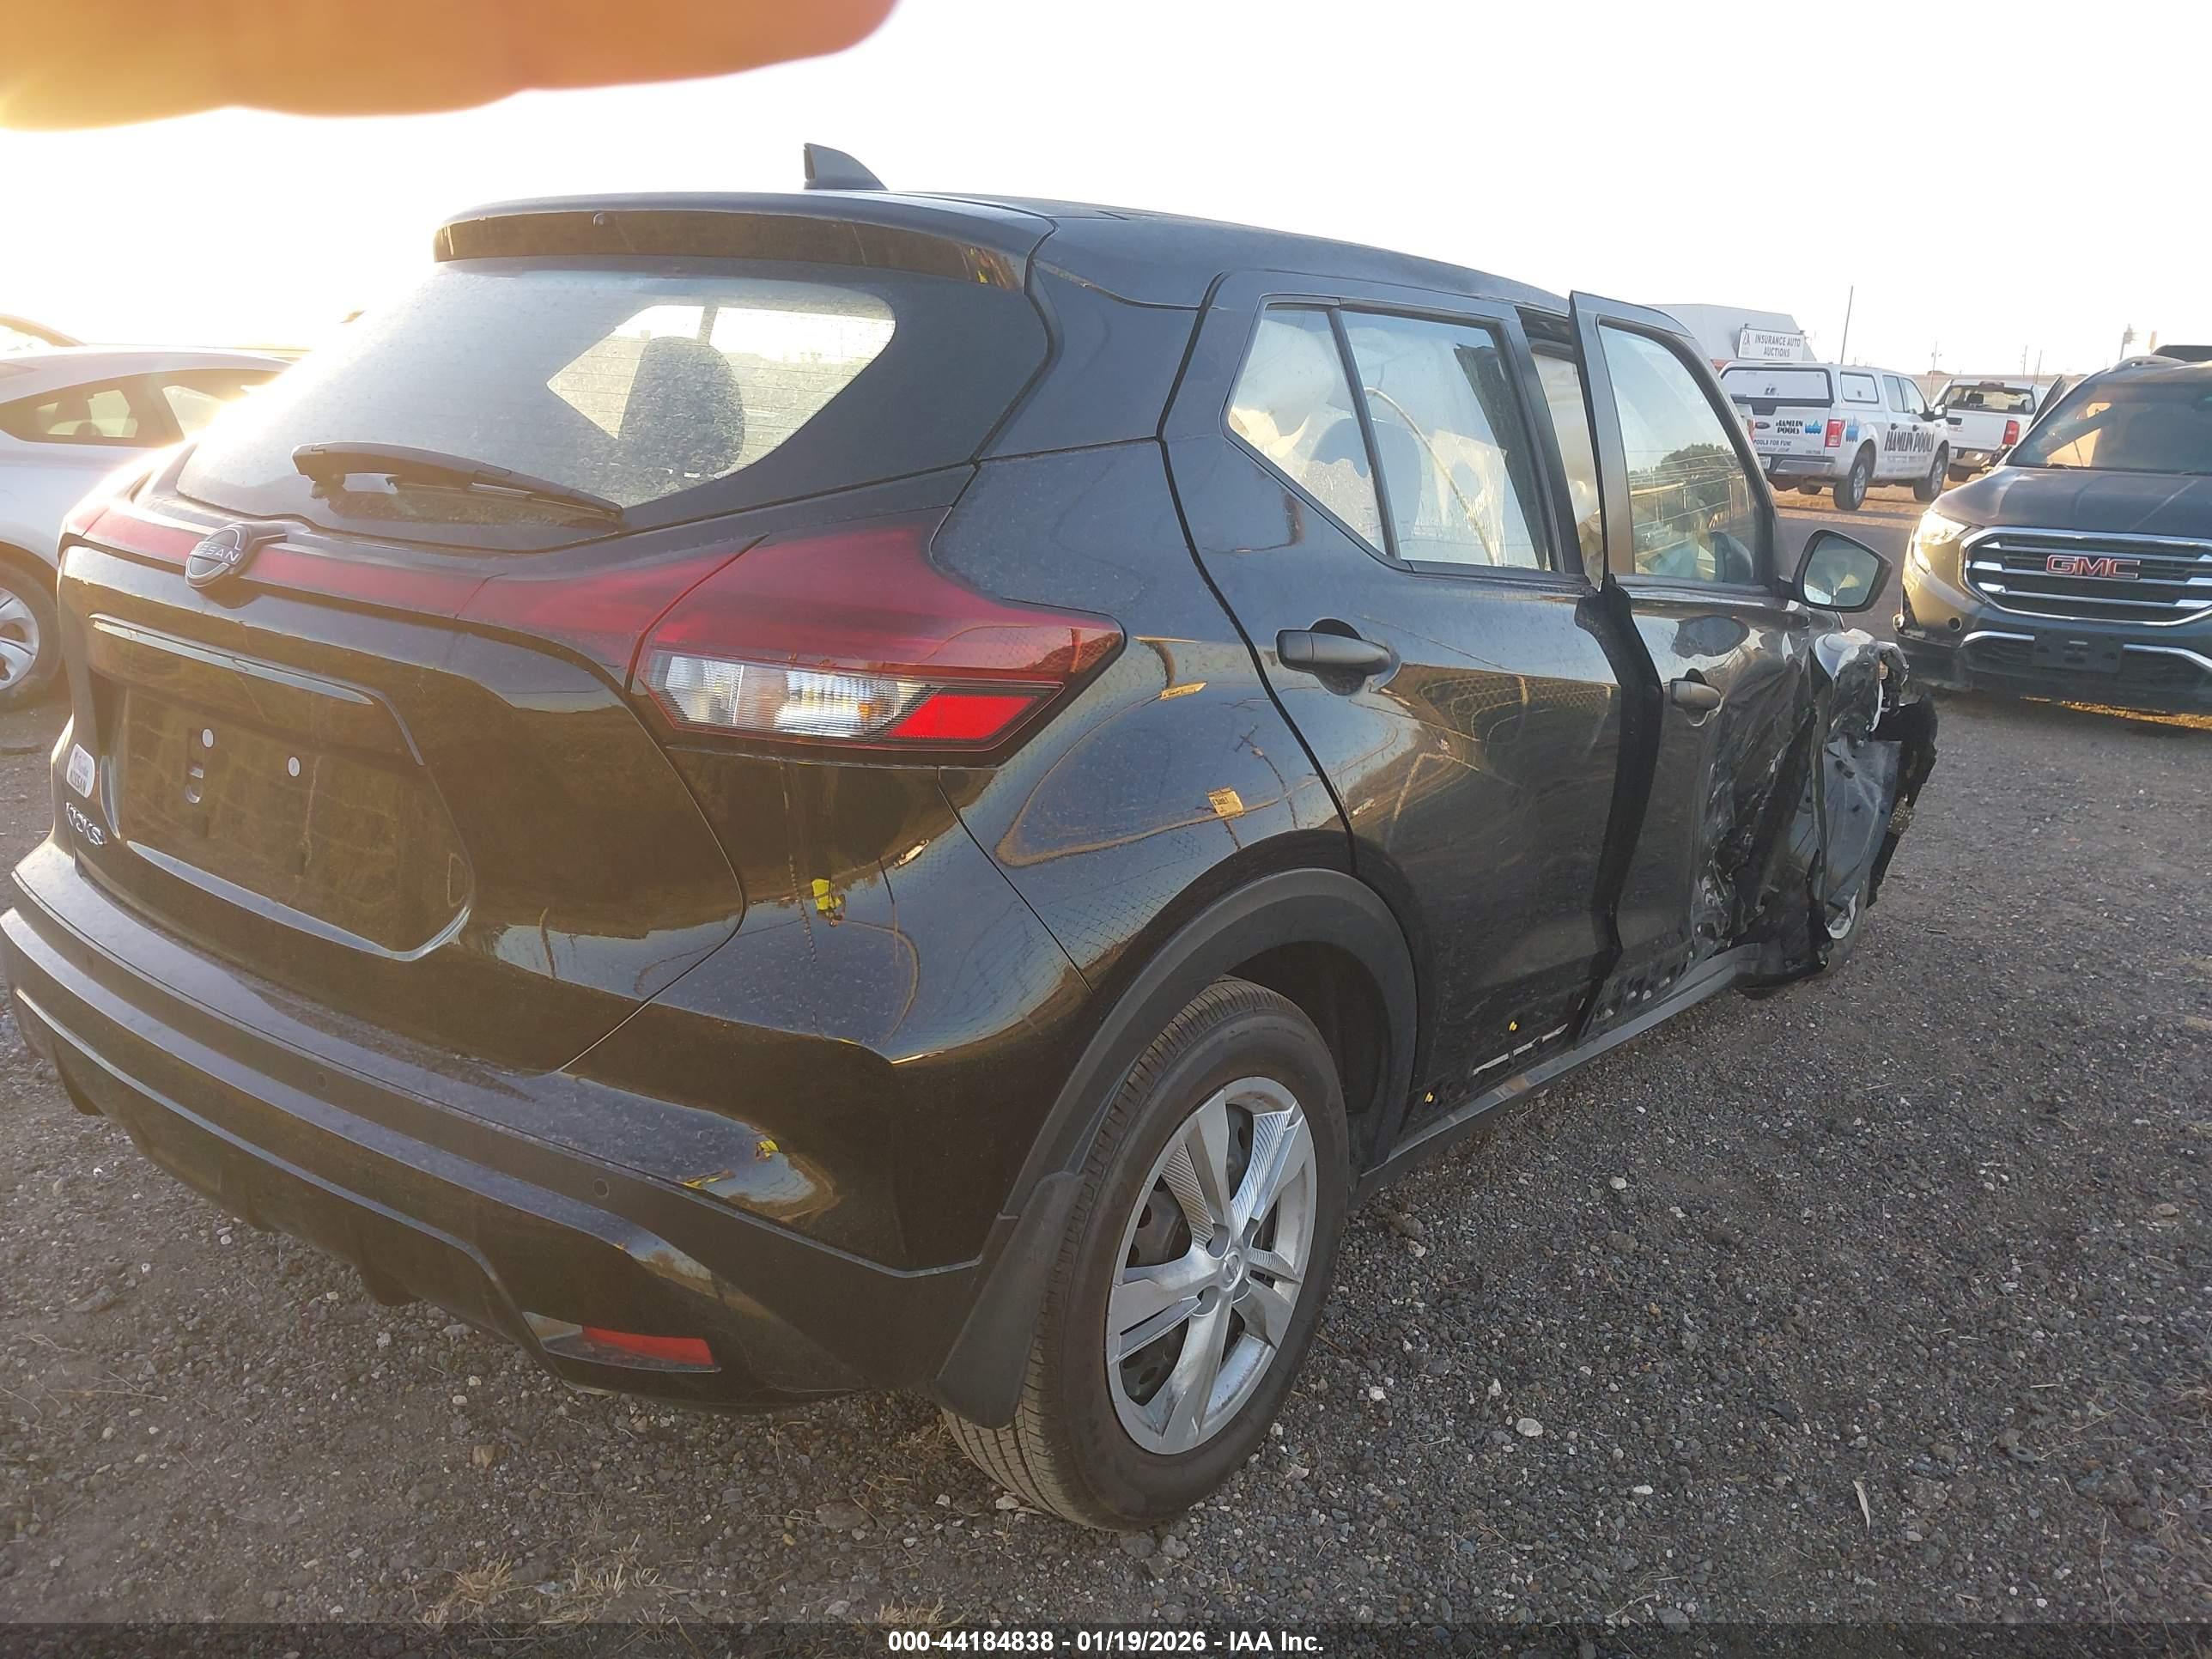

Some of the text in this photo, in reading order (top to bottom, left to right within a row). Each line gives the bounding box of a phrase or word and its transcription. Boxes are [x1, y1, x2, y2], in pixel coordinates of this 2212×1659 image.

[1755, 334, 1786, 346] INSURANCE
[1787, 338, 1801, 348] AUTO
[1763, 346, 1790, 357] AUCTIONS
[1884, 430, 1913, 452] HAMLIN
[192, 543, 241, 562] SSAN
[2045, 554, 2142, 580] GMC
